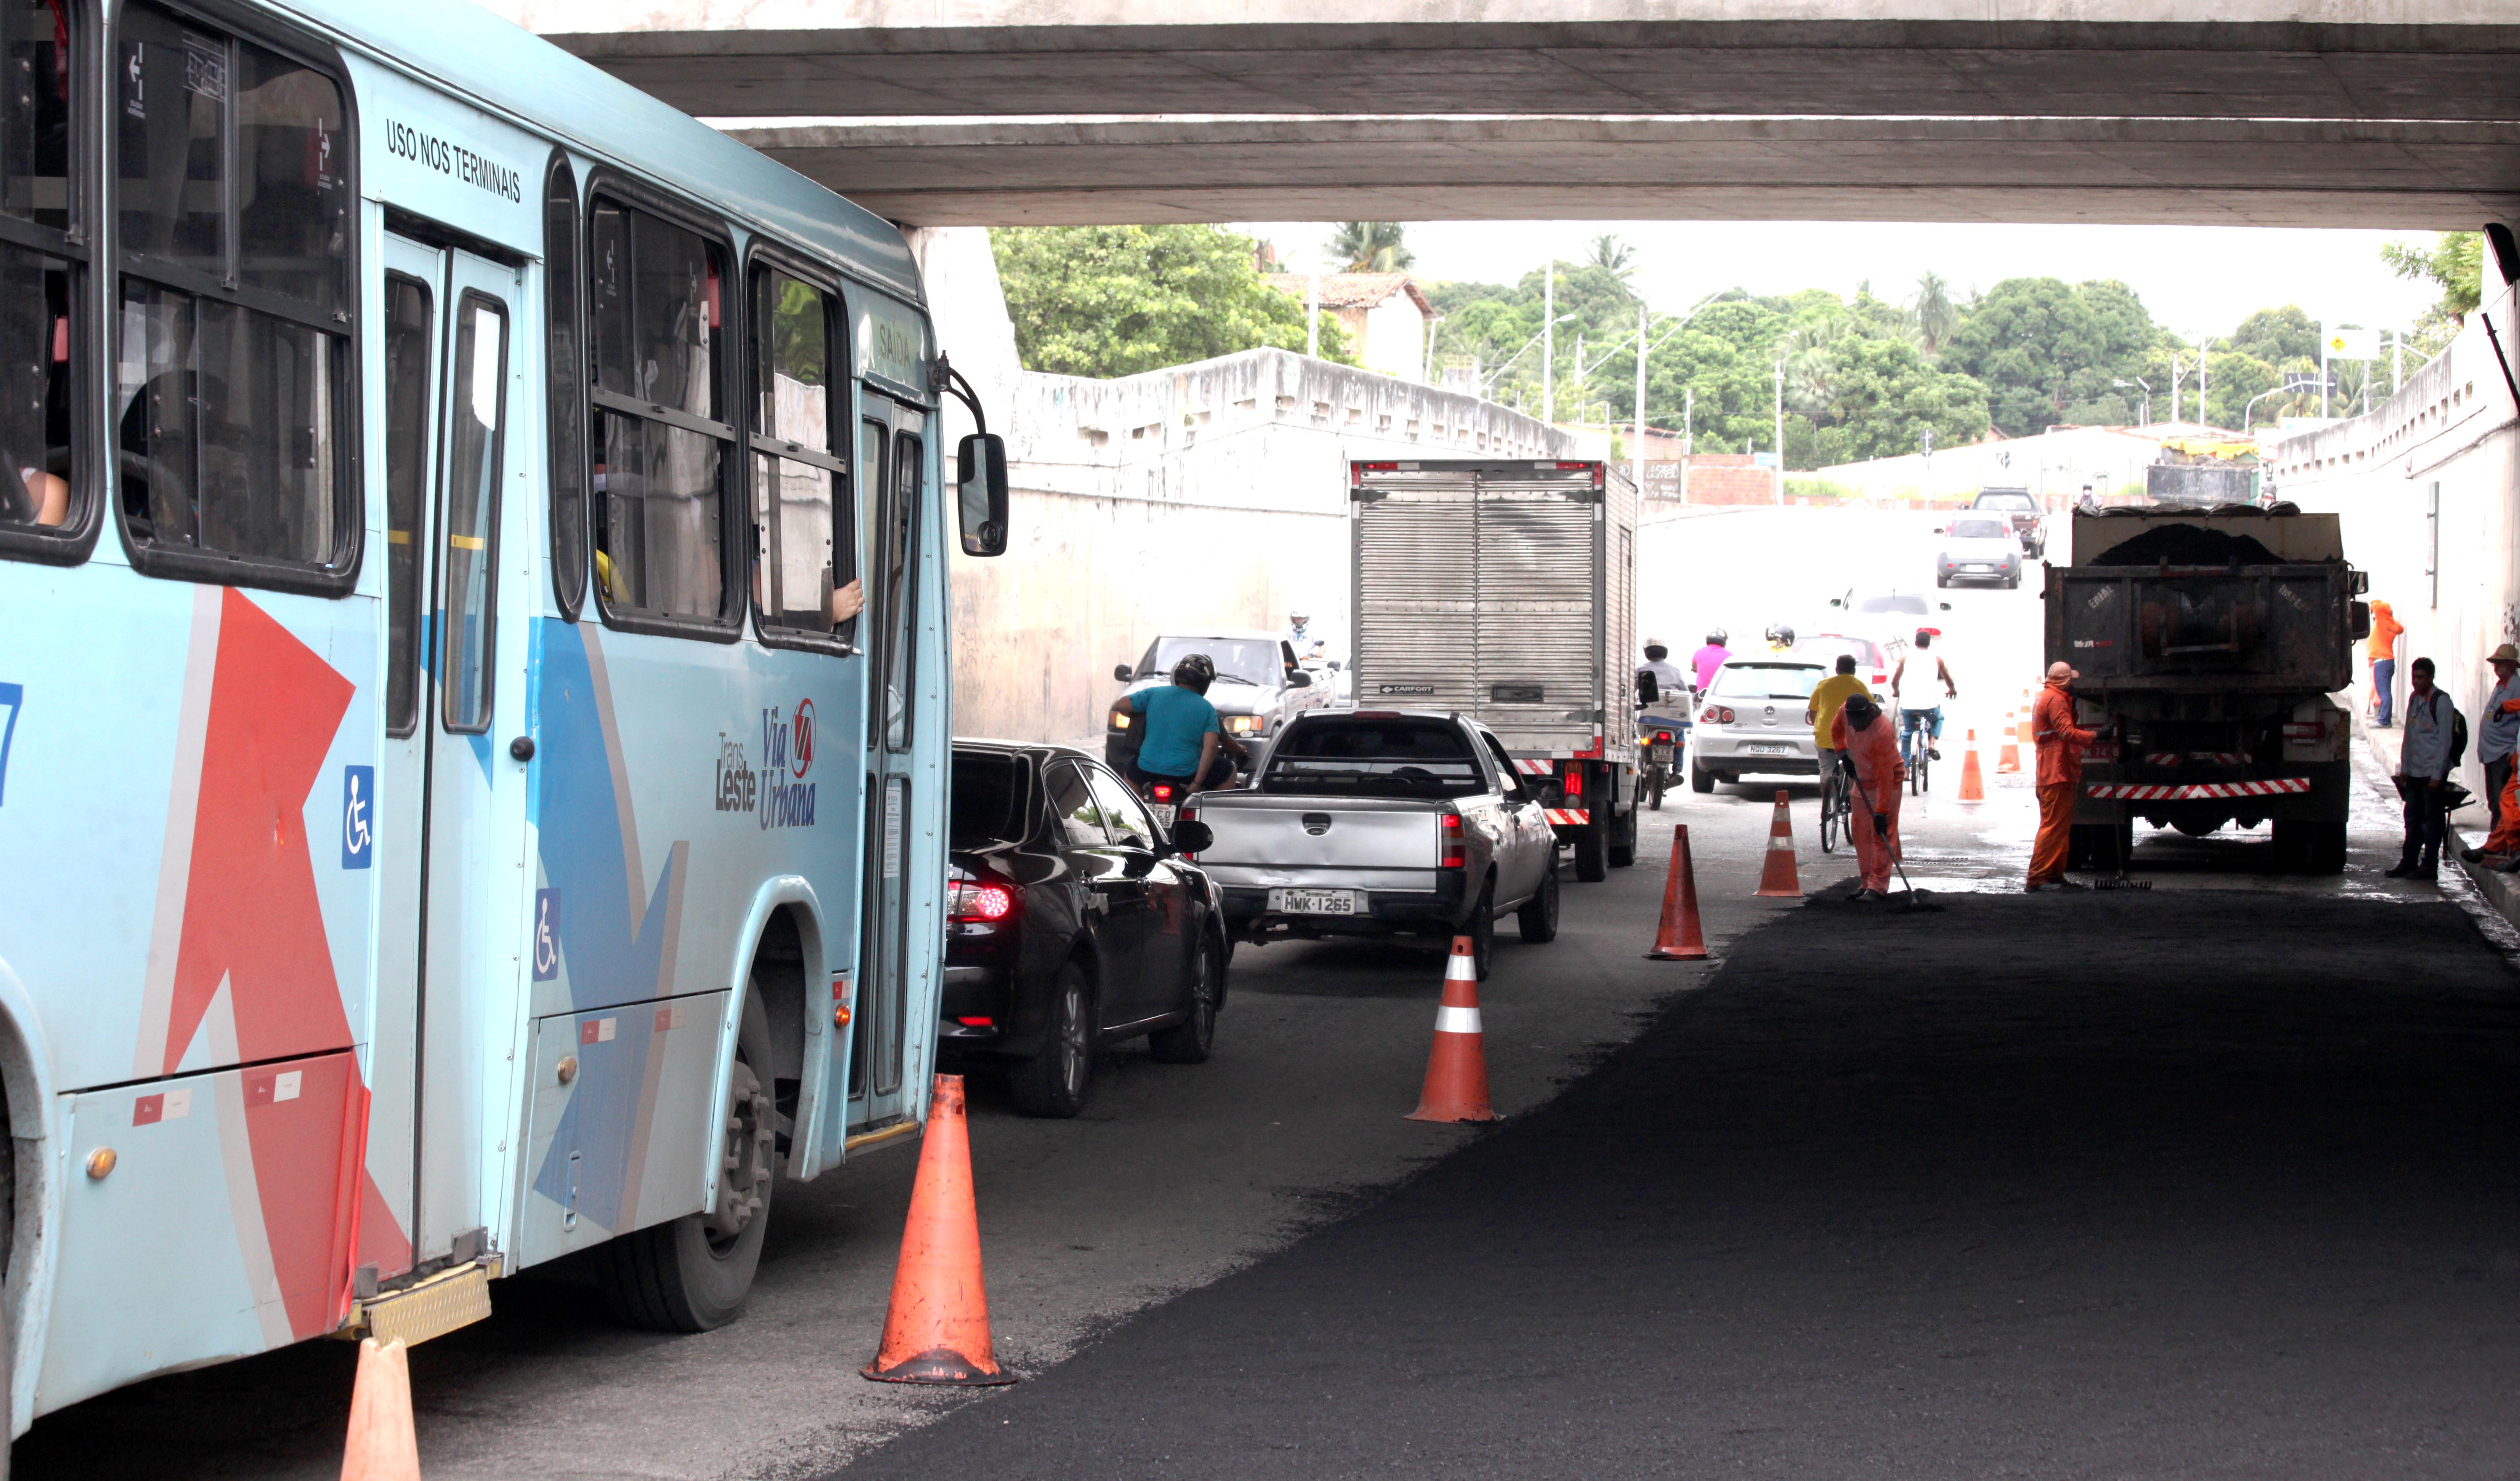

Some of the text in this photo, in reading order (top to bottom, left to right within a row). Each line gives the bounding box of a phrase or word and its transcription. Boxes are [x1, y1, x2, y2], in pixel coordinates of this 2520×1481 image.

[387, 118, 520, 203] USO NOS TERMINAIS
[880, 321, 911, 370] SAÍDA
[719, 732, 744, 769] Trans
[762, 706, 787, 768] Via
[716, 758, 756, 812] Leste
[760, 769, 816, 831] Urbana
